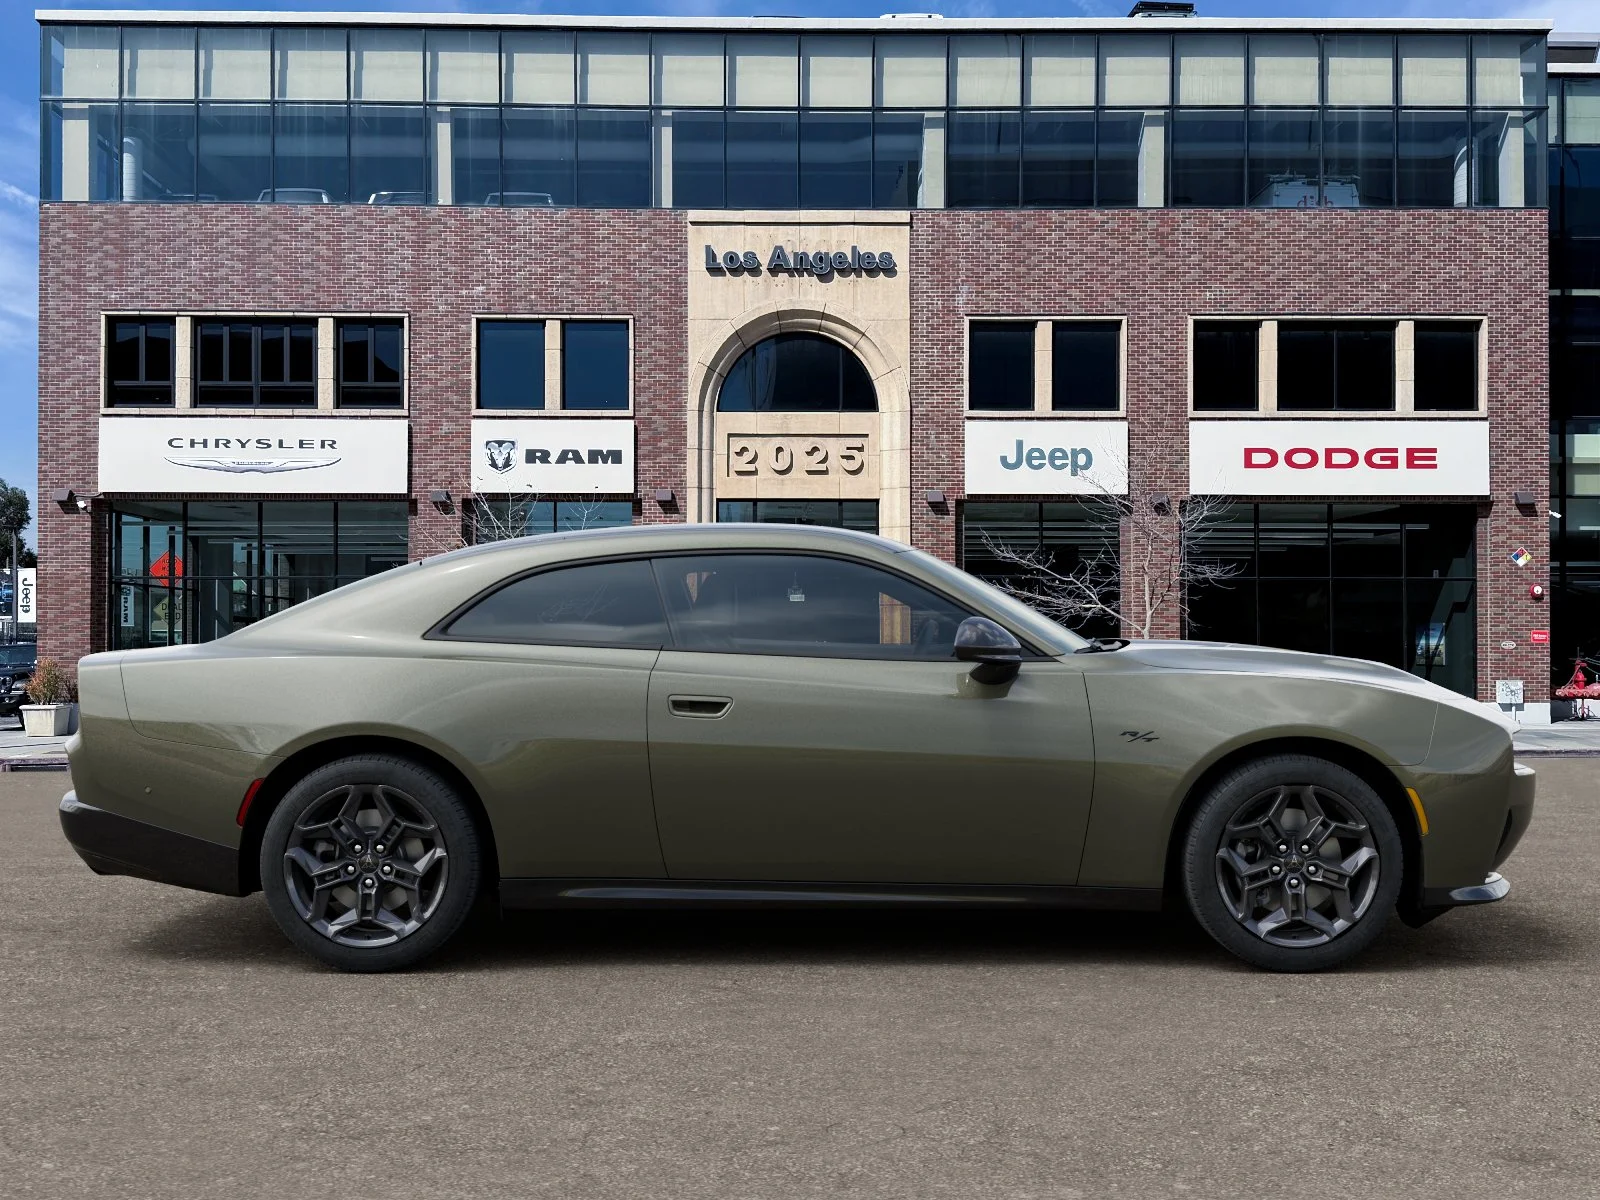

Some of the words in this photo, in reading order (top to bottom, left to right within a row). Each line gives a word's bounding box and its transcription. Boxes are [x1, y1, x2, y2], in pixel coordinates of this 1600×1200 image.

[704, 244, 759, 269] Los
[766, 245, 896, 276] Angeles
[167, 437, 339, 450] CHRYSLER
[524, 448, 623, 465] RAM
[733, 441, 866, 476] 2025
[999, 439, 1094, 477] Jeep
[1243, 447, 1439, 470] DODGE
[20, 577, 34, 614] Jeep
[164, 612, 181, 620] ED
